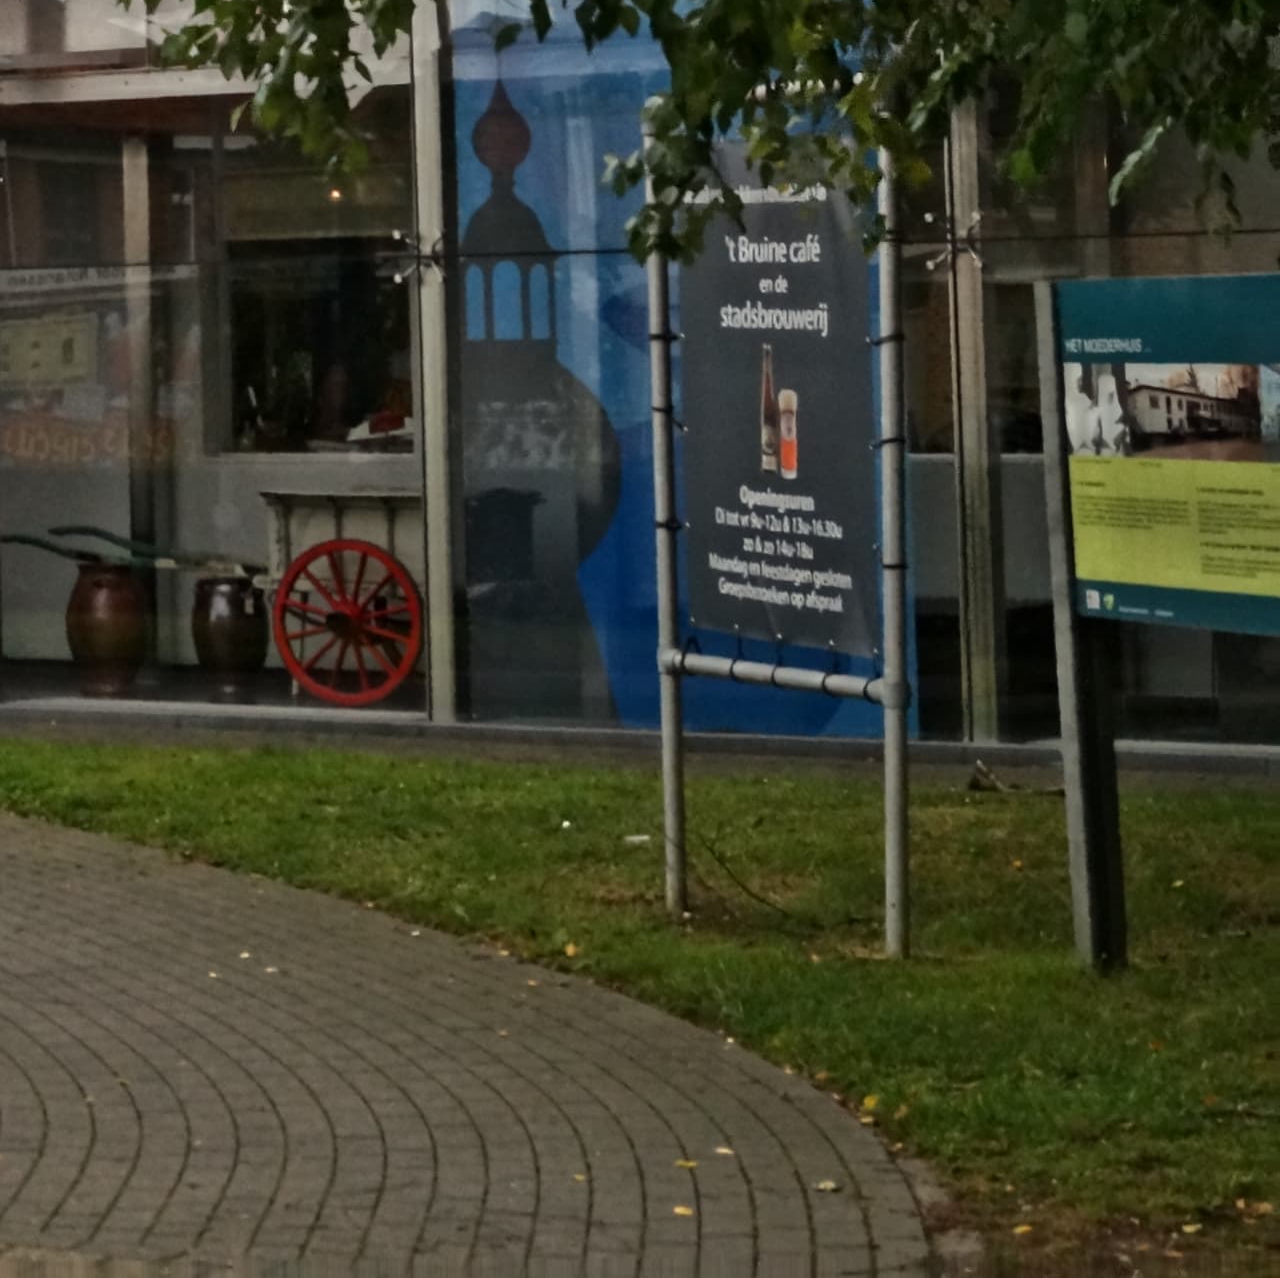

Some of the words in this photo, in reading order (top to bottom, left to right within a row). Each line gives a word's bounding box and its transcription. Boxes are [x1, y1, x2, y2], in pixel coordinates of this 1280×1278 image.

[738, 235, 787, 263] Bruine
[789, 233, 821, 263] café
[759, 278, 773, 293] en
[775, 274, 788, 293] de
[720, 300, 829, 337] stadsbrouwerij
